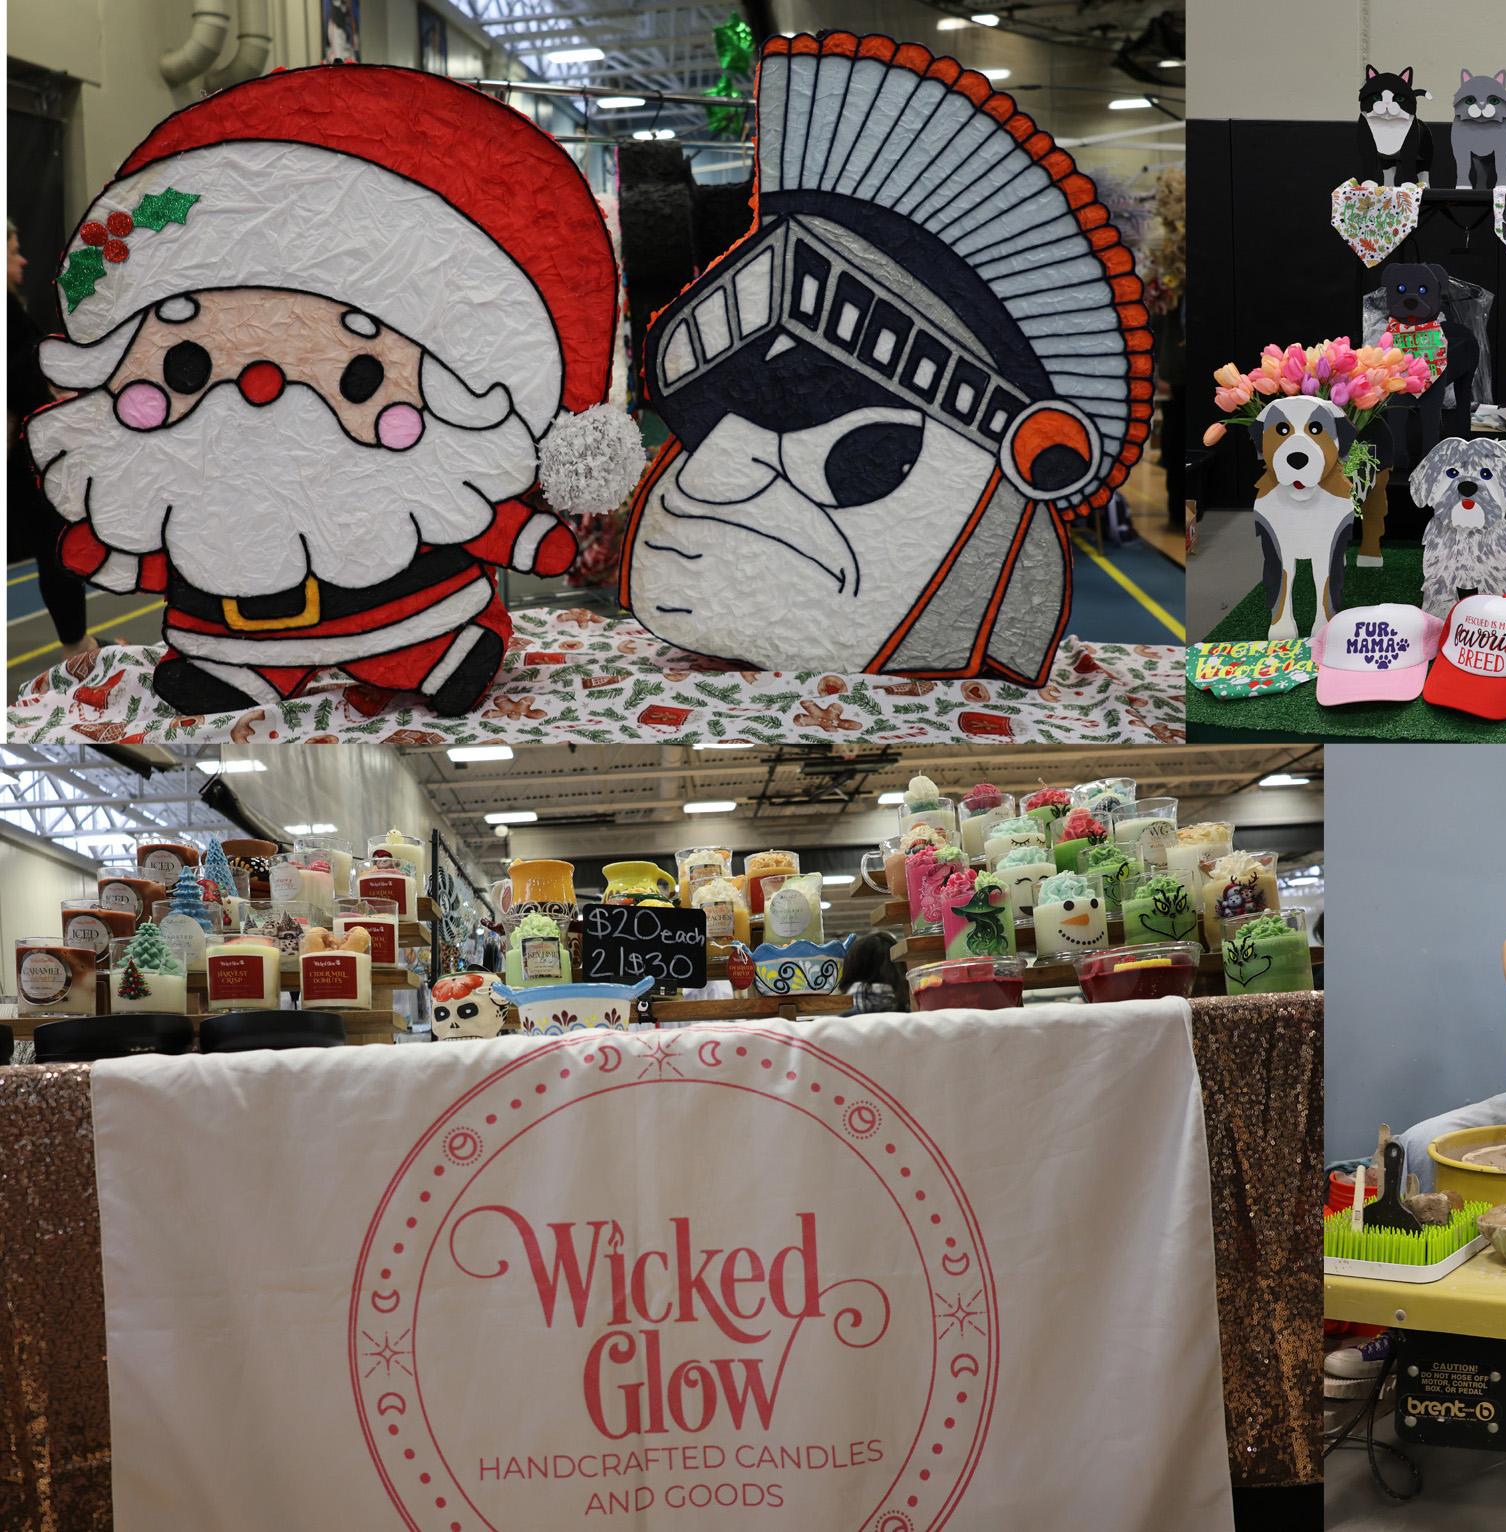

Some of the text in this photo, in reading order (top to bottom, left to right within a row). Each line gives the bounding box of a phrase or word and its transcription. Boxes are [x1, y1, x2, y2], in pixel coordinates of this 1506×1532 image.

[1354, 622, 1389, 637] FUR
[1465, 616, 1489, 629] RESCUED
[1491, 620, 1496, 628] IS
[1347, 638, 1396, 654] MAMA
[1458, 647, 1504, 672] BREED
[151, 862, 174, 872] ICED
[106, 895, 129, 904] ICED
[587, 907, 705, 945] $20 each
[72, 929, 99, 939] ICED
[23, 967, 62, 976] CARAMEL
[449, 1204, 891, 1348] Wicked
[1433, 1362, 1478, 1372] CAUTION!
[583, 1330, 776, 1440] Glow
[1452, 1380, 1488, 1389] CONTROL
[1458, 1387, 1483, 1395] PEDAL
[1407, 1396, 1466, 1417] brent
[479, 1439, 885, 1482] HANDCRAFTED CANDLES
[584, 1483, 785, 1516] AND GOODS
